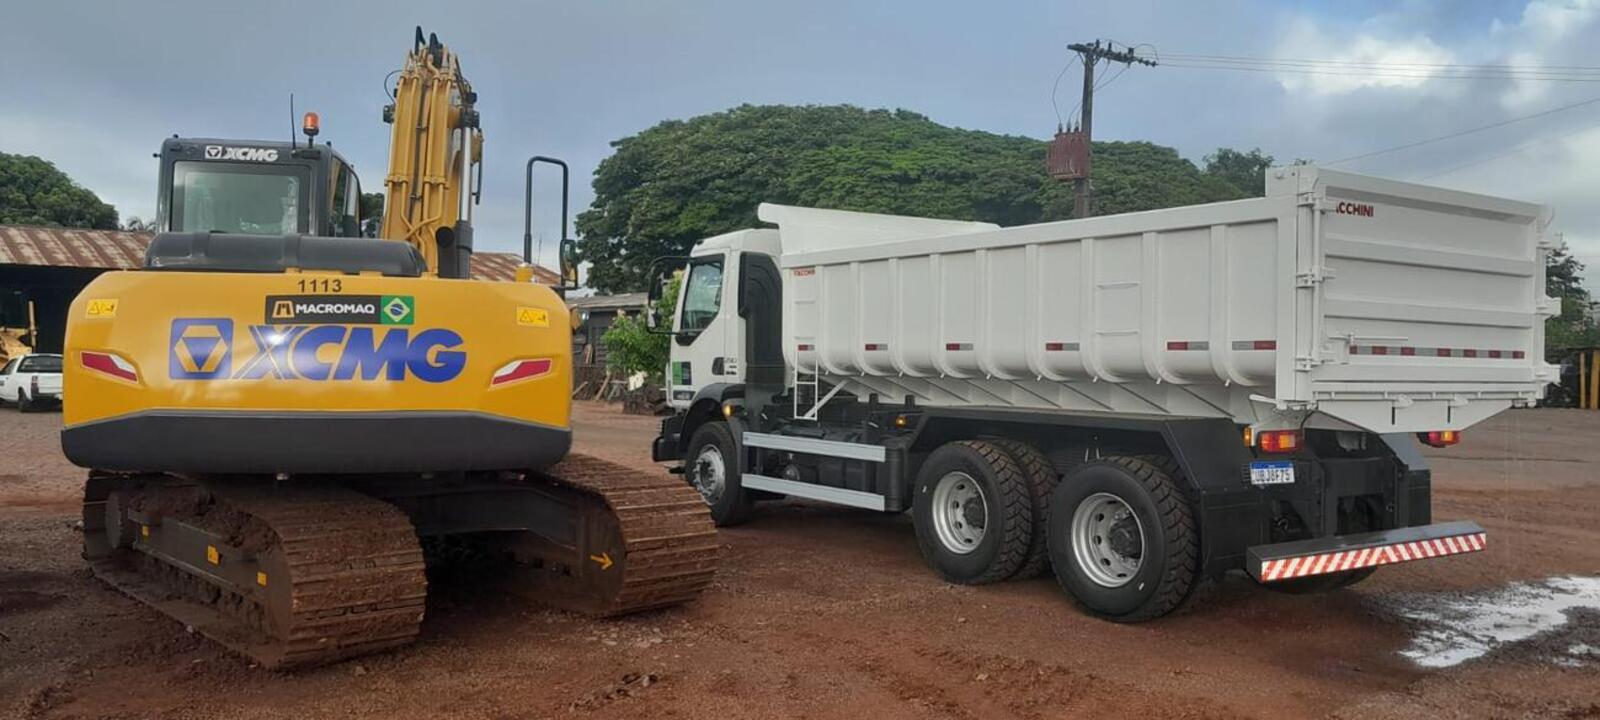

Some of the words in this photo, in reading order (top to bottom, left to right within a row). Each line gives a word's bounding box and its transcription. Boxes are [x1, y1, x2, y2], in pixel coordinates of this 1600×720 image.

[223, 147, 278, 162] XCMG
[1336, 201, 1374, 217] CCHINI
[298, 279, 342, 293] 1113
[296, 303, 375, 314] MACROMAQ
[233, 325, 467, 383] XCMG
